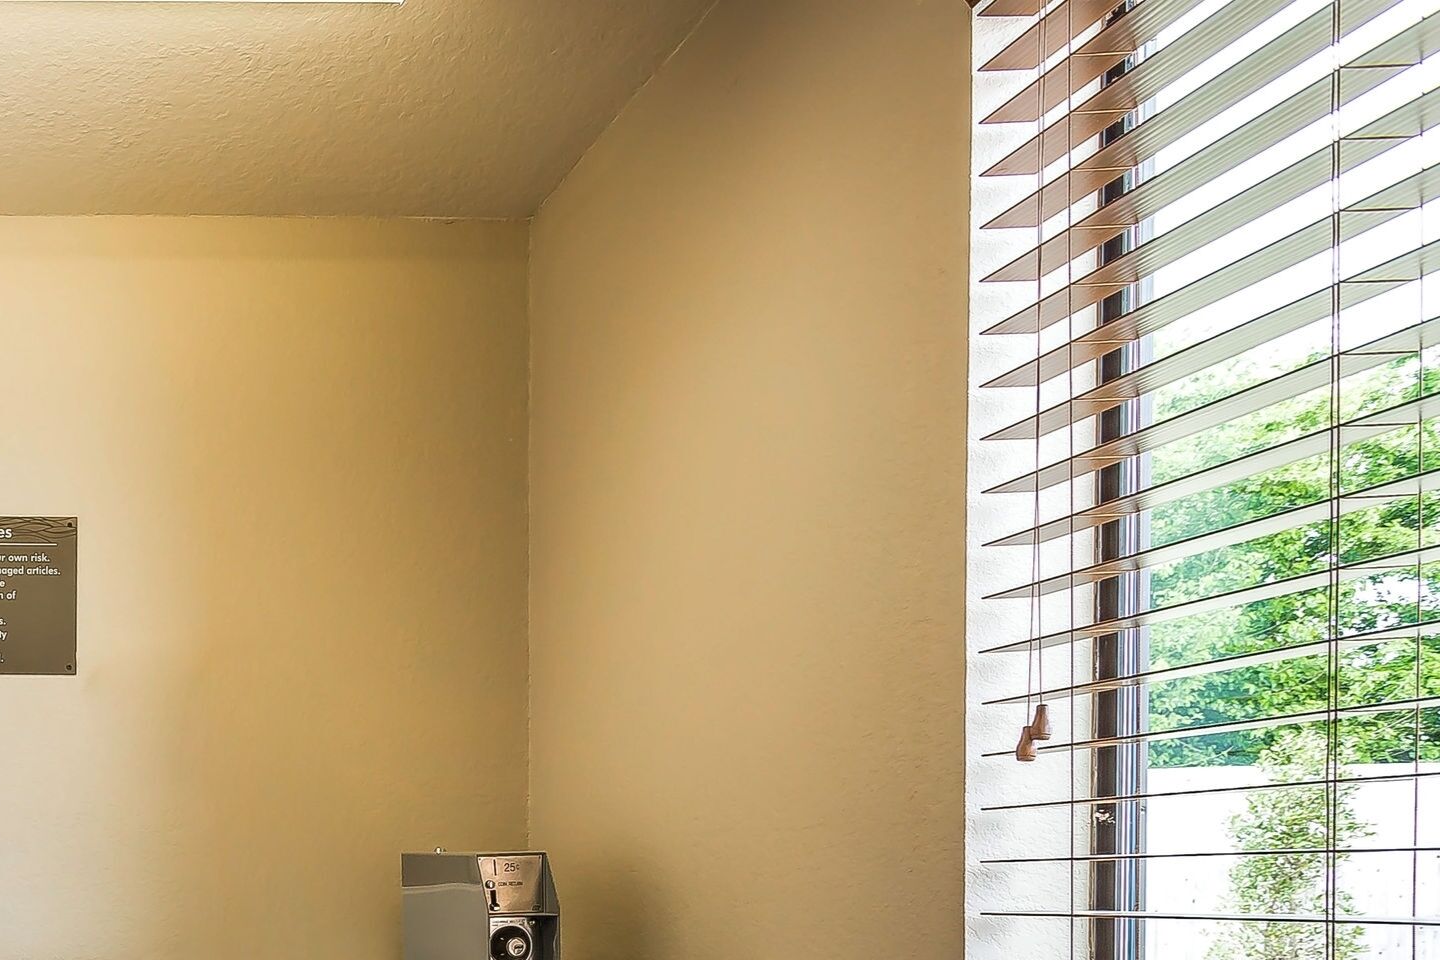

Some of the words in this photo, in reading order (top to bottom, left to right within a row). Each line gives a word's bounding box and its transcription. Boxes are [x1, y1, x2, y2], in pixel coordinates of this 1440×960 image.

[30, 552, 50, 562] risk.
[26, 565, 61, 575] articles.
[6, 590, 17, 600] of
